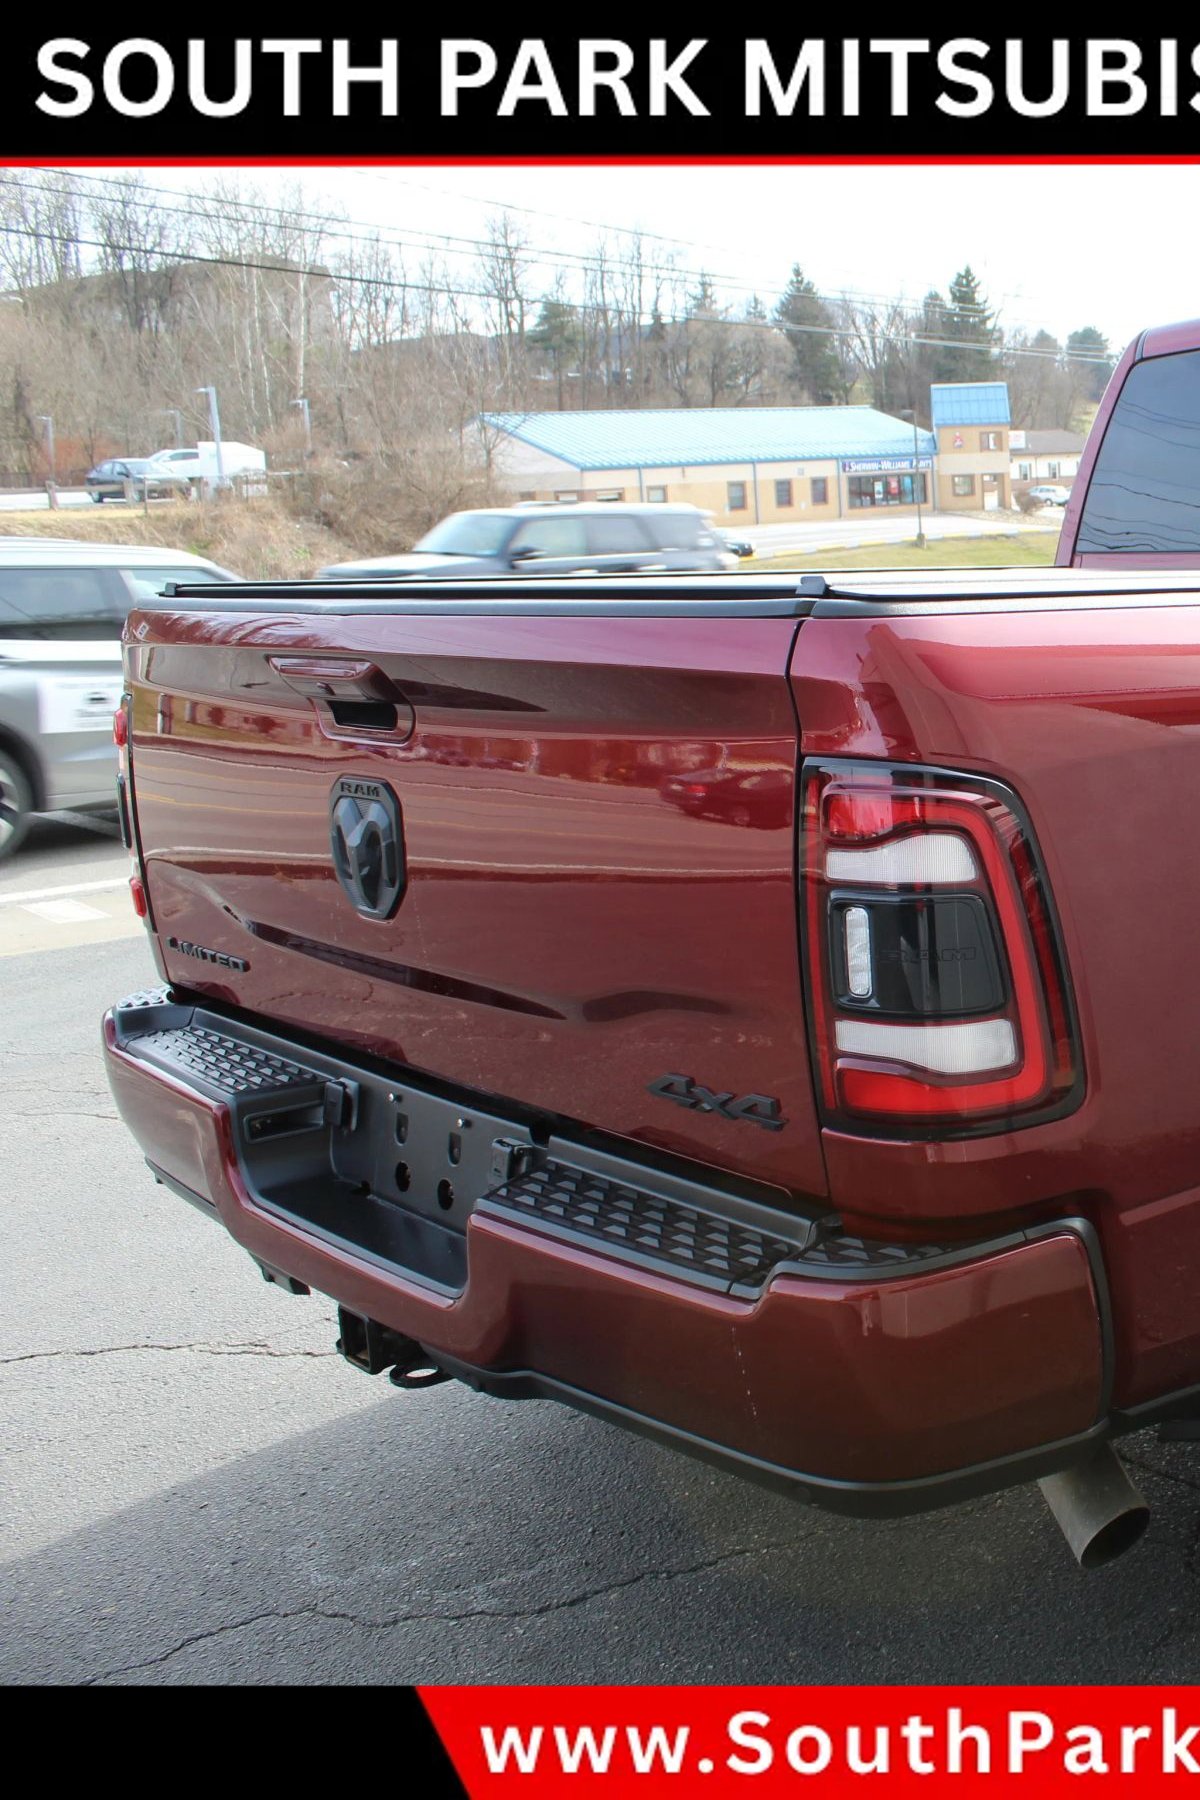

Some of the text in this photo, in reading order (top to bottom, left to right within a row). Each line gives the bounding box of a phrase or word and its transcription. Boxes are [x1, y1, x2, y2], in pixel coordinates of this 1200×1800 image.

[850, 460, 911, 472] SHERWIN-WILLIAMS
[340, 782, 381, 798] RAM
[166, 936, 251, 973] LIMITED
